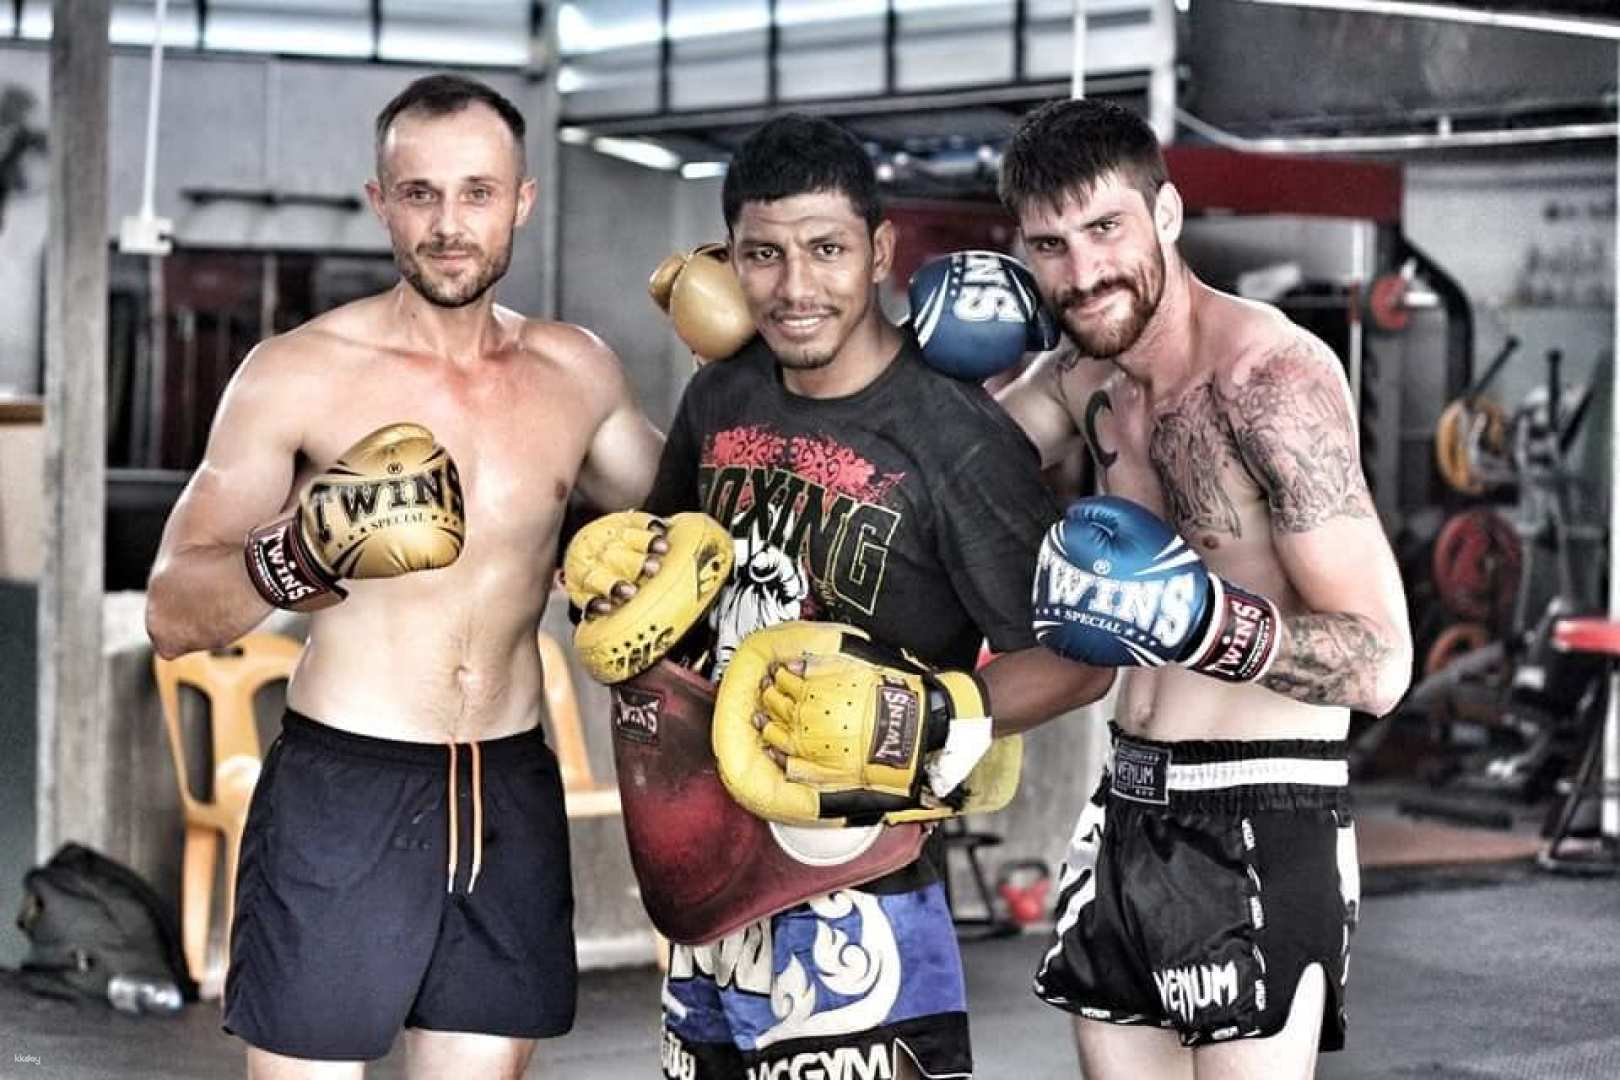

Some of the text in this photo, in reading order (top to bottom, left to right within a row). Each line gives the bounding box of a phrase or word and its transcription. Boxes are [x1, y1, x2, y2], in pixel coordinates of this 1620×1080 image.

[370, 512, 424, 530] SPECIAL
[1064, 607, 1123, 634] SPECIAL
[876, 691, 909, 759] TWINS
[1152, 960, 1238, 1023] VENUM
